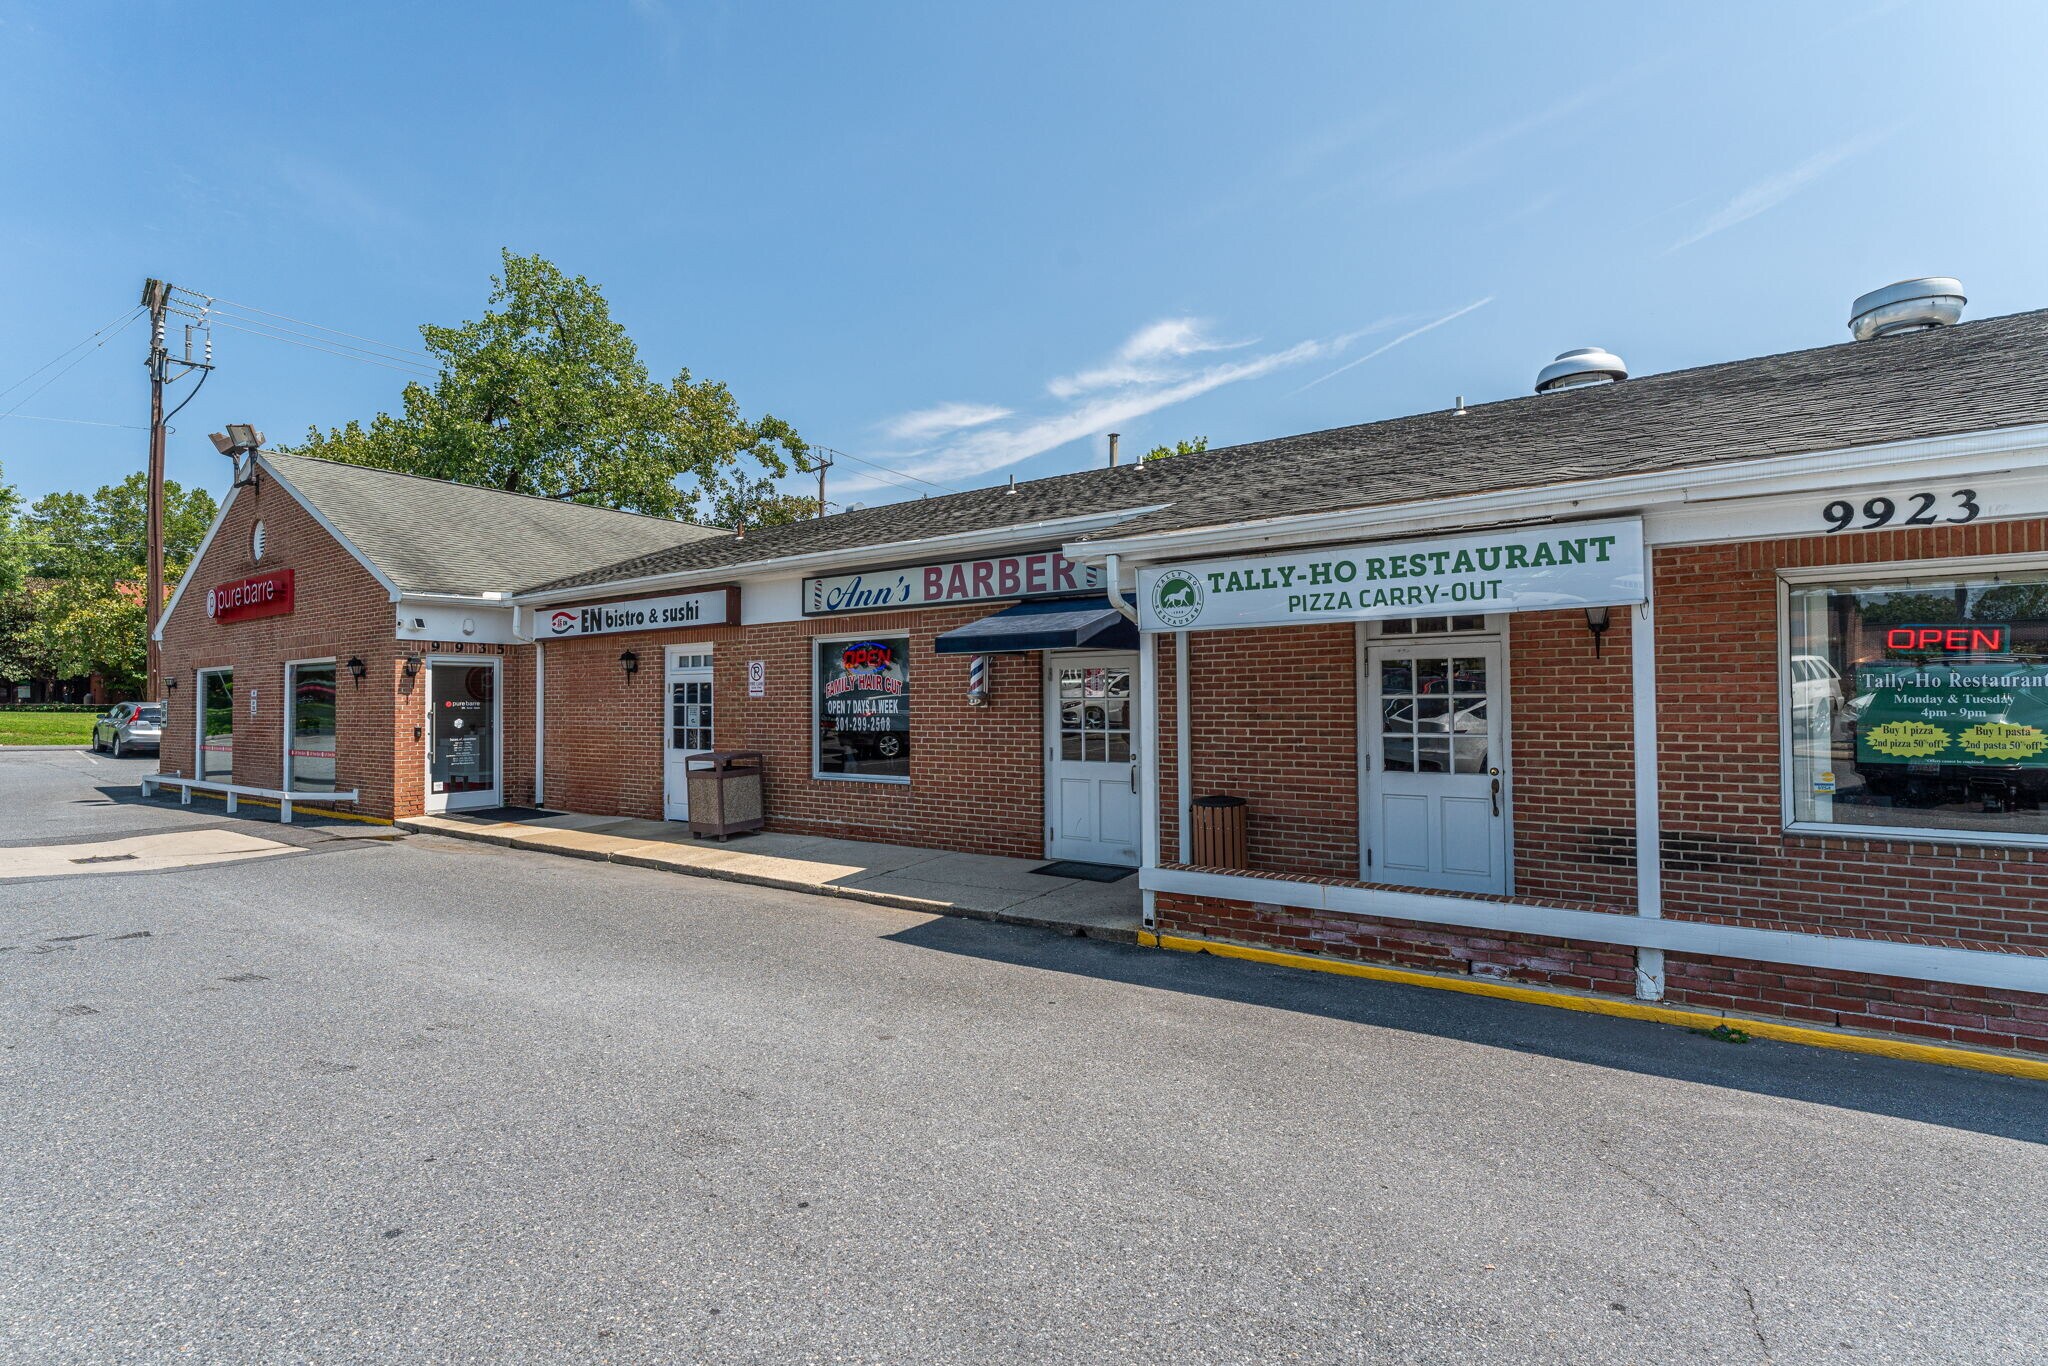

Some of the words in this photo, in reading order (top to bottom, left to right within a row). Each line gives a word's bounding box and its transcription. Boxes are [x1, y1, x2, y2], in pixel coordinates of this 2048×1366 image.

[1823, 489, 1980, 534] 9923
[1207, 560, 1357, 594] TALLY-HO
[1365, 535, 1616, 581] RESTAURANT
[826, 575, 911, 610] Ann's
[923, 553, 1078, 601] BARBER
[1157, 572, 1182, 589] TALLY
[1187, 575, 1198, 586] HO
[218, 587, 242, 616] pure
[243, 580, 274, 605] barre
[1288, 591, 1353, 613] PIZZA
[1359, 580, 1503, 608] CARRY-OUT
[581, 608, 602, 633] EN
[605, 609, 645, 629] bistro
[649, 608, 659, 624] &
[662, 599, 699, 623] sushi
[1155, 601, 1202, 625] RESTAURANT
[431, 641, 504, 654] 9935
[1887, 629, 2000, 650] OPEN
[842, 648, 892, 668] OPEN
[826, 675, 855, 699] FAMILY
[858, 674, 883, 691] HAIR
[884, 677, 903, 697] CUT
[1862, 672, 1942, 691] Tally-Ho
[1949, 672, 2048, 688] Restaurant
[828, 701, 846, 714] OPEN
[847, 701, 851, 714] 7
[853, 700, 870, 714] DAYS
[872, 700, 877, 714] A
[878, 699, 899, 714] WEEK
[1894, 694, 1945, 706] Monday
[1948, 694, 1959, 704] &
[1963, 693, 2015, 706] Tuesday
[1921, 708, 1947, 719] 4pm
[1959, 708, 1986, 719] 9pm
[1883, 726, 1899, 736] Buy
[1903, 726, 1907, 734] 1
[1910, 726, 1934, 737] pizza
[1975, 726, 1994, 737] Buy
[1998, 726, 2002, 735] 1
[2005, 727, 2031, 738] pasta
[1873, 739, 1888, 747] 2nd
[1890, 740, 1911, 749] pizza
[1965, 740, 1981, 749] 2nd
[1983, 742, 2007, 751] pasta
